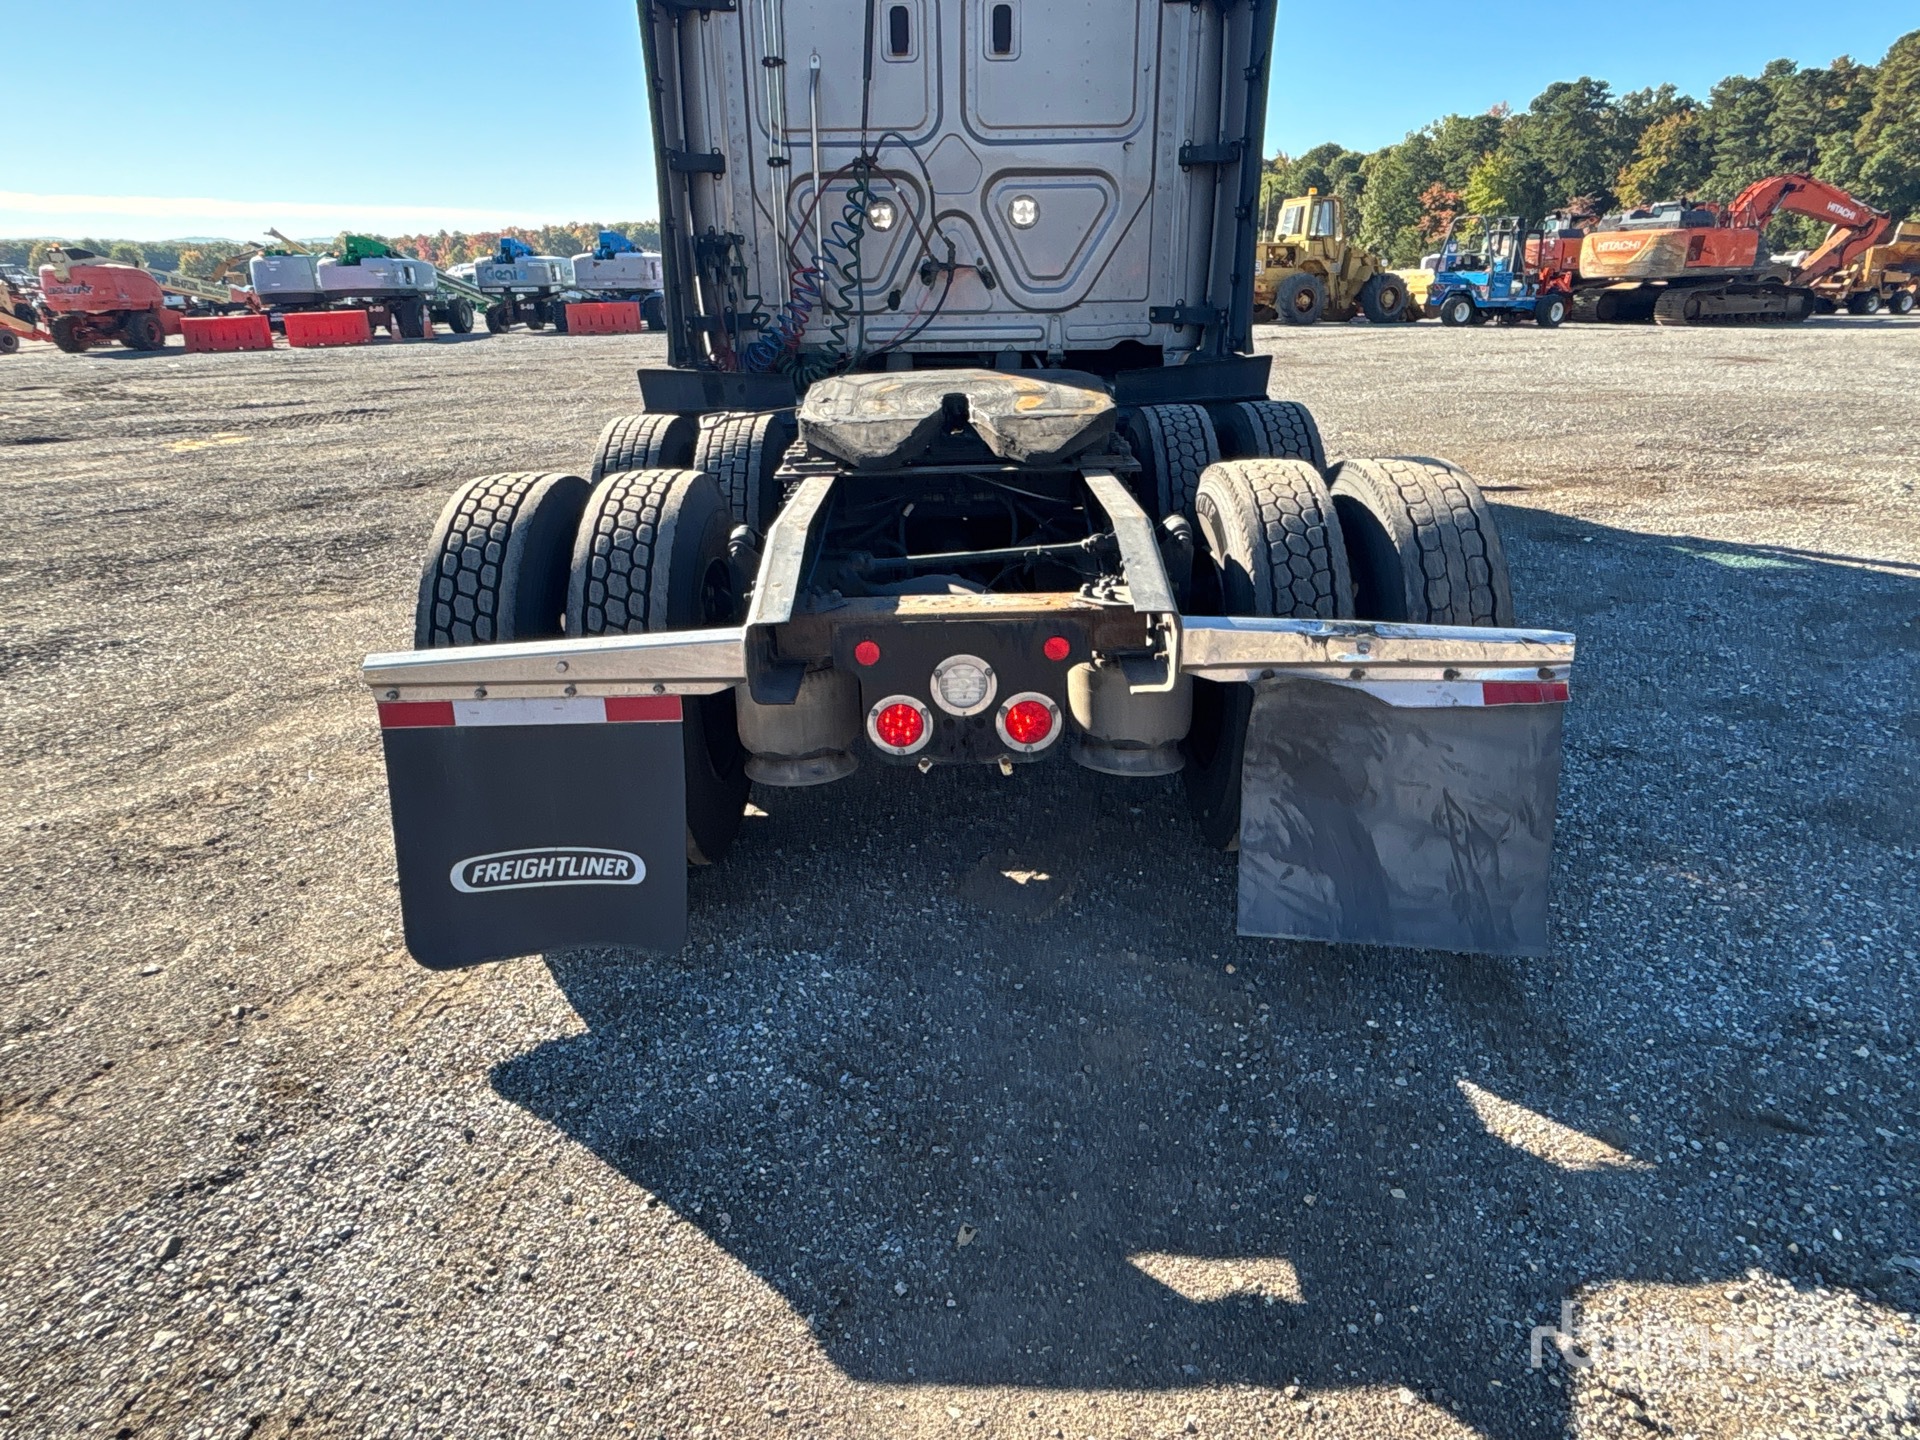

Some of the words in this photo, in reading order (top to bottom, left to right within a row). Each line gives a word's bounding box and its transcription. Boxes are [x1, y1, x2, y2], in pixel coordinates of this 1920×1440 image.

[1827, 201, 1857, 220] HITACHI
[1597, 240, 1642, 252] HITACHI
[484, 266, 528, 281] Genie
[471, 856, 629, 884] FREIGHTLINER
